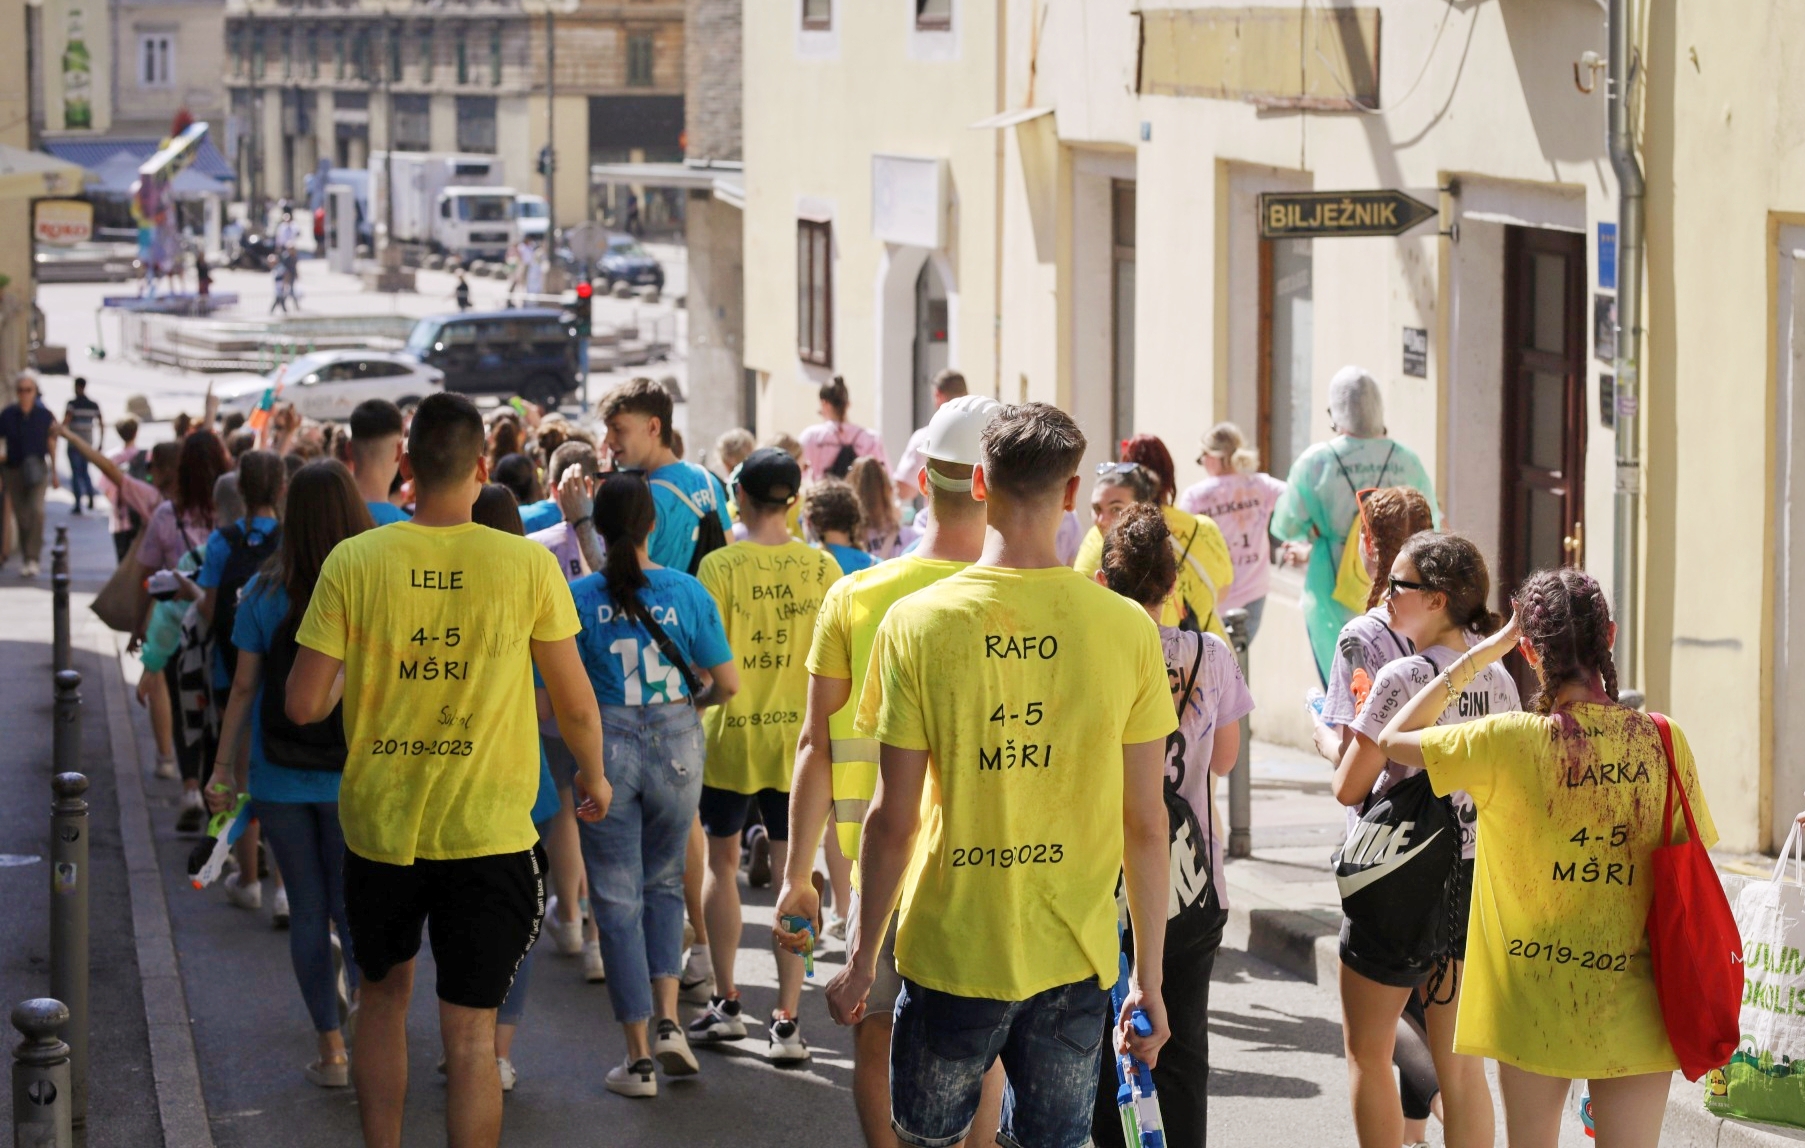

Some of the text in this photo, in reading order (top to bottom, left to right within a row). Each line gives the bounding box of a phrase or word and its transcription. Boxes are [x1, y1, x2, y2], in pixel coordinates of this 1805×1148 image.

[1270, 199, 1398, 228] BILJEŽNIK
[411, 568, 464, 590] LELE
[752, 585, 794, 600] BATA
[411, 627, 461, 648] 4-5
[985, 635, 1058, 660] RAFO
[399, 656, 469, 681] MŠRI
[989, 701, 1044, 728] 4-5
[372, 739, 474, 756] 2019-2023
[1567, 761, 1650, 788] LARKA
[1569, 824, 1628, 847] 4-5
[1552, 856, 1635, 886] MŠRI
[1508, 939, 1636, 972] 2019-202
